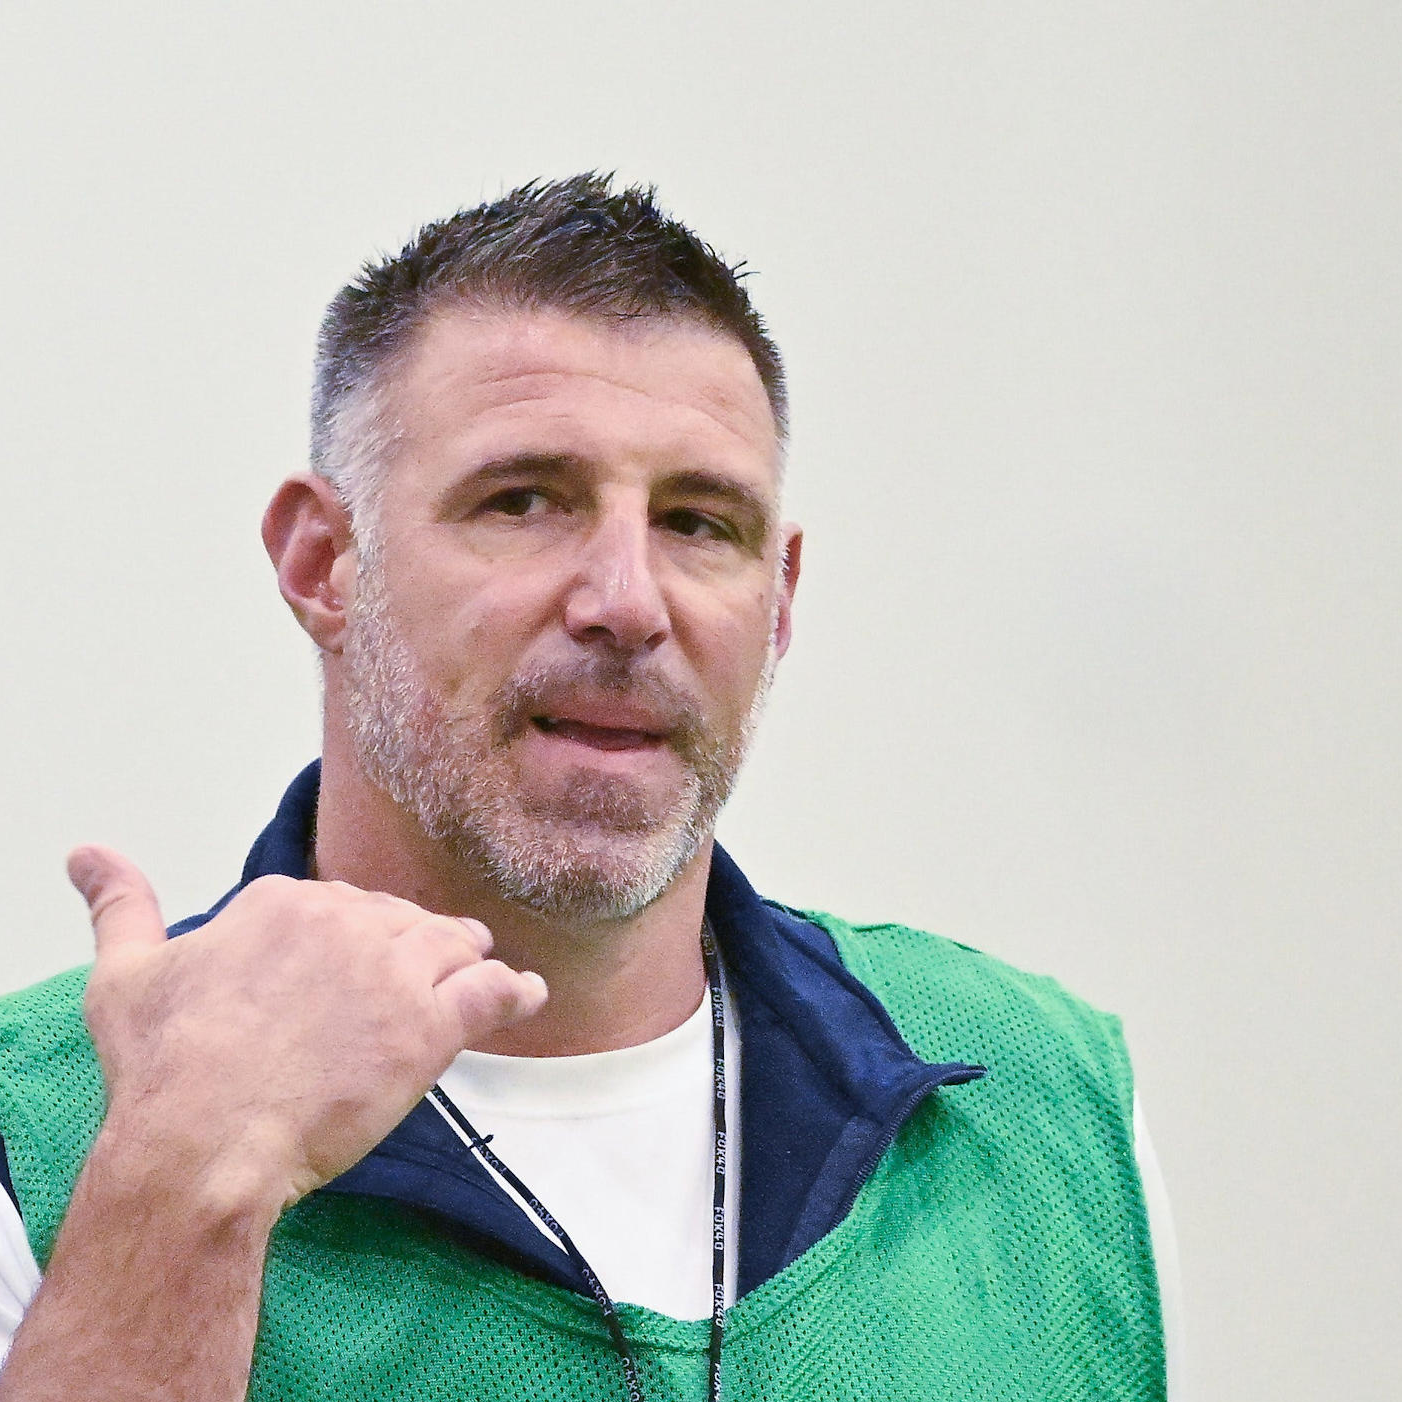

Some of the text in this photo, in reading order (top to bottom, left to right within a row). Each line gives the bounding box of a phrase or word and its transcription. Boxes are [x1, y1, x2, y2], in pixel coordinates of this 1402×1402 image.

[715, 1058, 726, 1100] FOX40
[715, 1131, 727, 1175] FOX40
[713, 1206, 725, 1250] FOX40
[714, 1283, 725, 1327] FOX40
